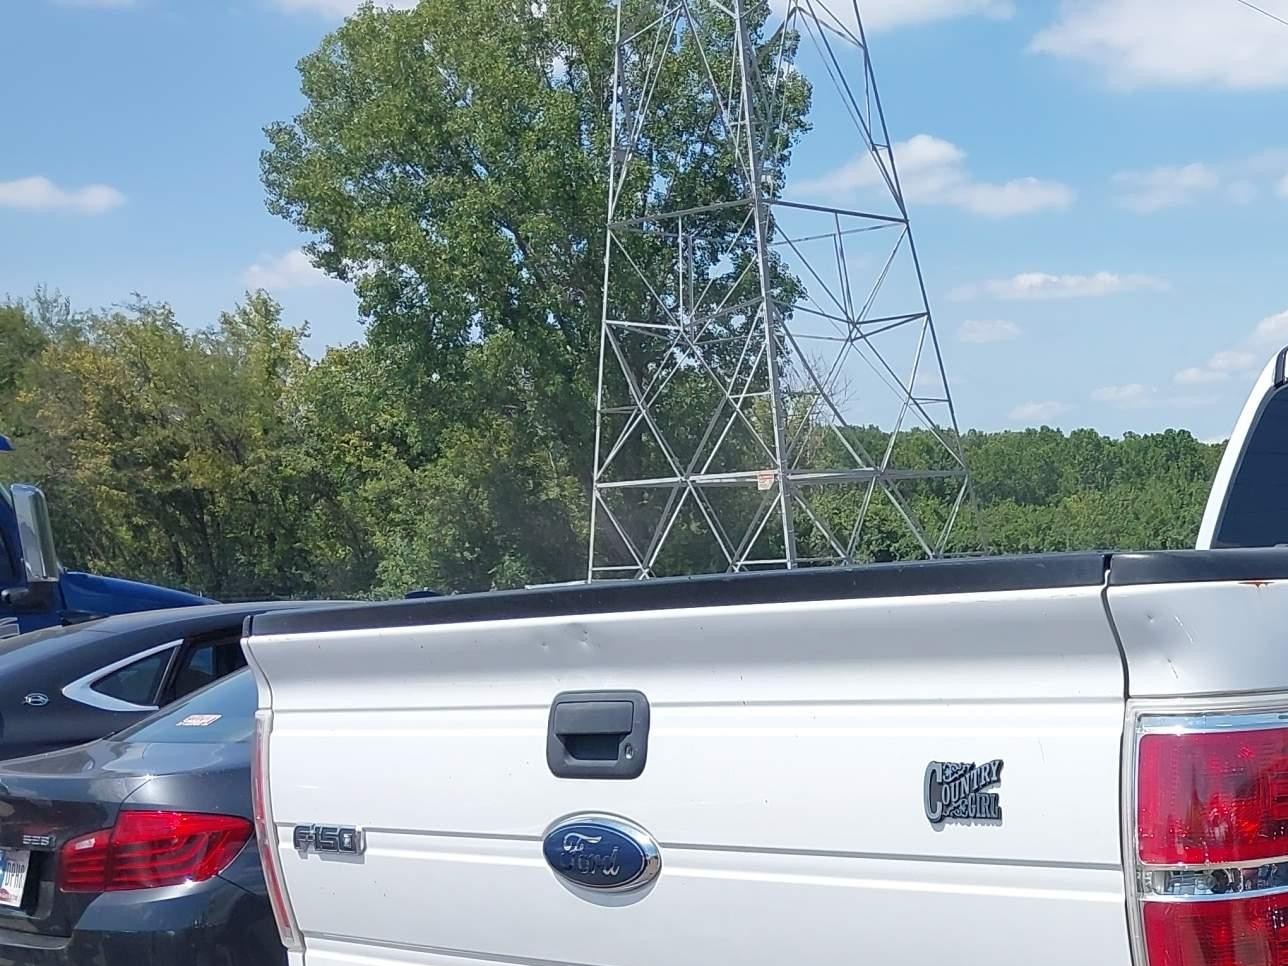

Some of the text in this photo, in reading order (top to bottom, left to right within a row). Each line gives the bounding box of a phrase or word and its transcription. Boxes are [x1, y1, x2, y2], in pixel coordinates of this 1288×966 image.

[924, 759, 1003, 823] COUNTRY
[968, 792, 1001, 819] GIRL
[560, 832, 621, 877] Ford
